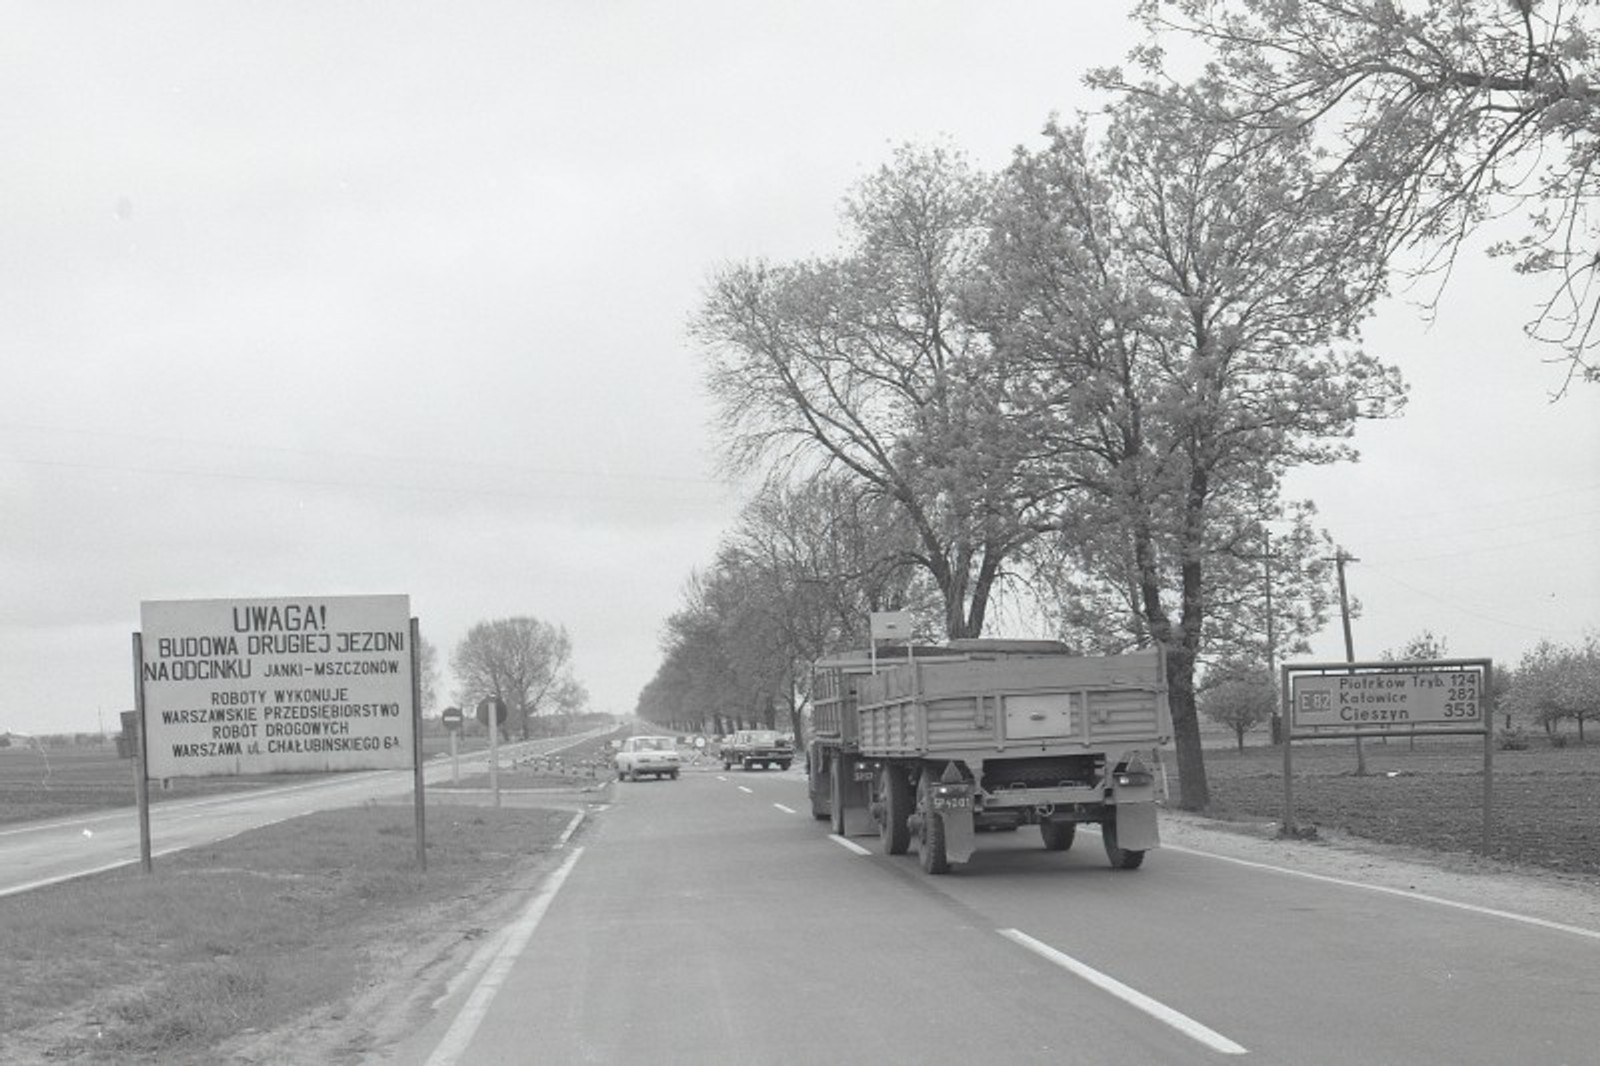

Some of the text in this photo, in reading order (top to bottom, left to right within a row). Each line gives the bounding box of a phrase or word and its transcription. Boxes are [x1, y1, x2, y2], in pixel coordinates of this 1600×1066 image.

[233, 605, 326, 632] UWAGA!
[159, 632, 404, 657] BUDOWA DRUGIEJ JEZDNI
[1450, 674, 1476, 687] 124
[211, 688, 348, 705] ROBOTY WYKONUJE
[1340, 689, 1475, 704] Katowice 282
[162, 708, 257, 724] WARSZAWSKIE
[1340, 703, 1476, 721] Cieszyn 353
[266, 722, 349, 736] DROGOWYCH
[172, 742, 242, 757] WARSZAWA
